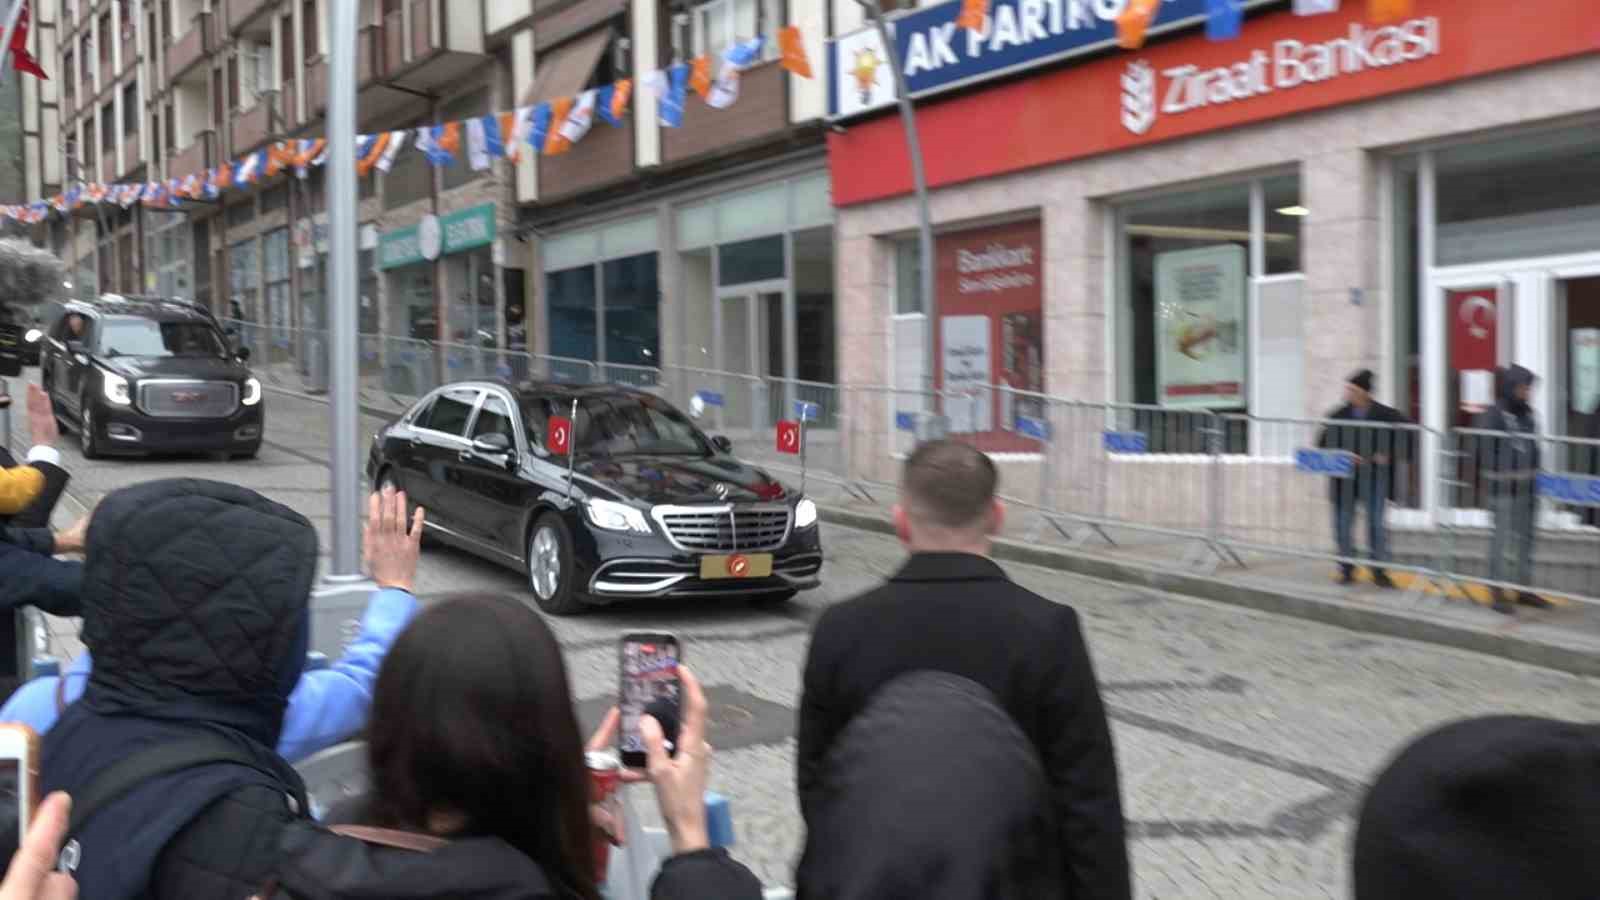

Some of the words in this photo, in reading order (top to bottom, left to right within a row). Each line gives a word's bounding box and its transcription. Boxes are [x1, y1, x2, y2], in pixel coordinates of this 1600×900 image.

[902, 22, 959, 76] AK
[1160, 48, 1272, 114] Ziraat
[1272, 16, 1440, 88] Bankası
